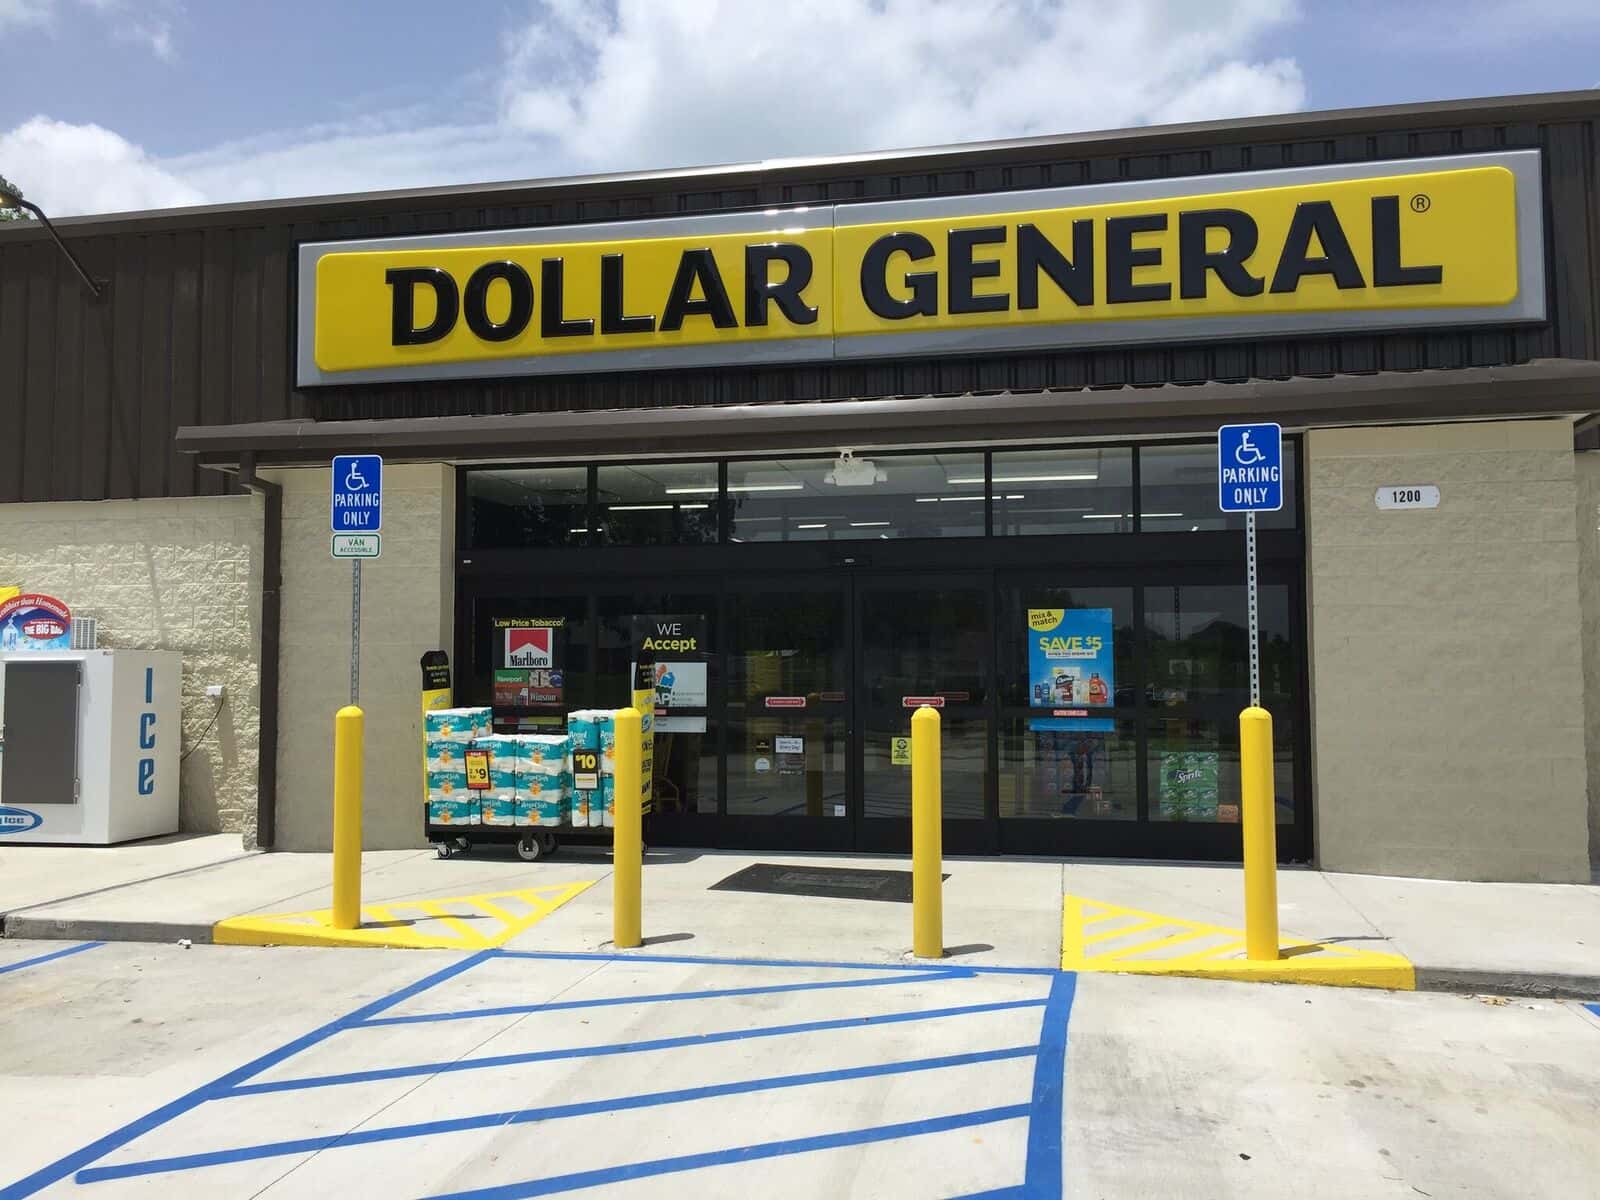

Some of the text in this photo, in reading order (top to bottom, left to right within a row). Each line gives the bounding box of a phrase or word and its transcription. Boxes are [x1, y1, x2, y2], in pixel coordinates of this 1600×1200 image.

[386, 242, 820, 346] DOLLAR
[860, 194, 1443, 320] GENERAL
[1223, 465, 1279, 483] PARKING
[335, 492, 379, 507] PARKING
[1234, 487, 1268, 505] ONLY
[1393, 490, 1421, 503] 1200
[343, 511, 370, 526] ONLY
[348, 538, 365, 546] VAN
[495, 619, 510, 627] Low
[511, 619, 530, 627] Price
[1031, 611, 1044, 620] mix
[1032, 616, 1058, 627] match
[35, 624, 49, 635] BIG
[656, 623, 682, 636] WE
[642, 637, 697, 652] Accept
[1040, 636, 1103, 651] SAVE $5
[509, 651, 548, 667] Marlboro
[575, 754, 596, 769] $10
